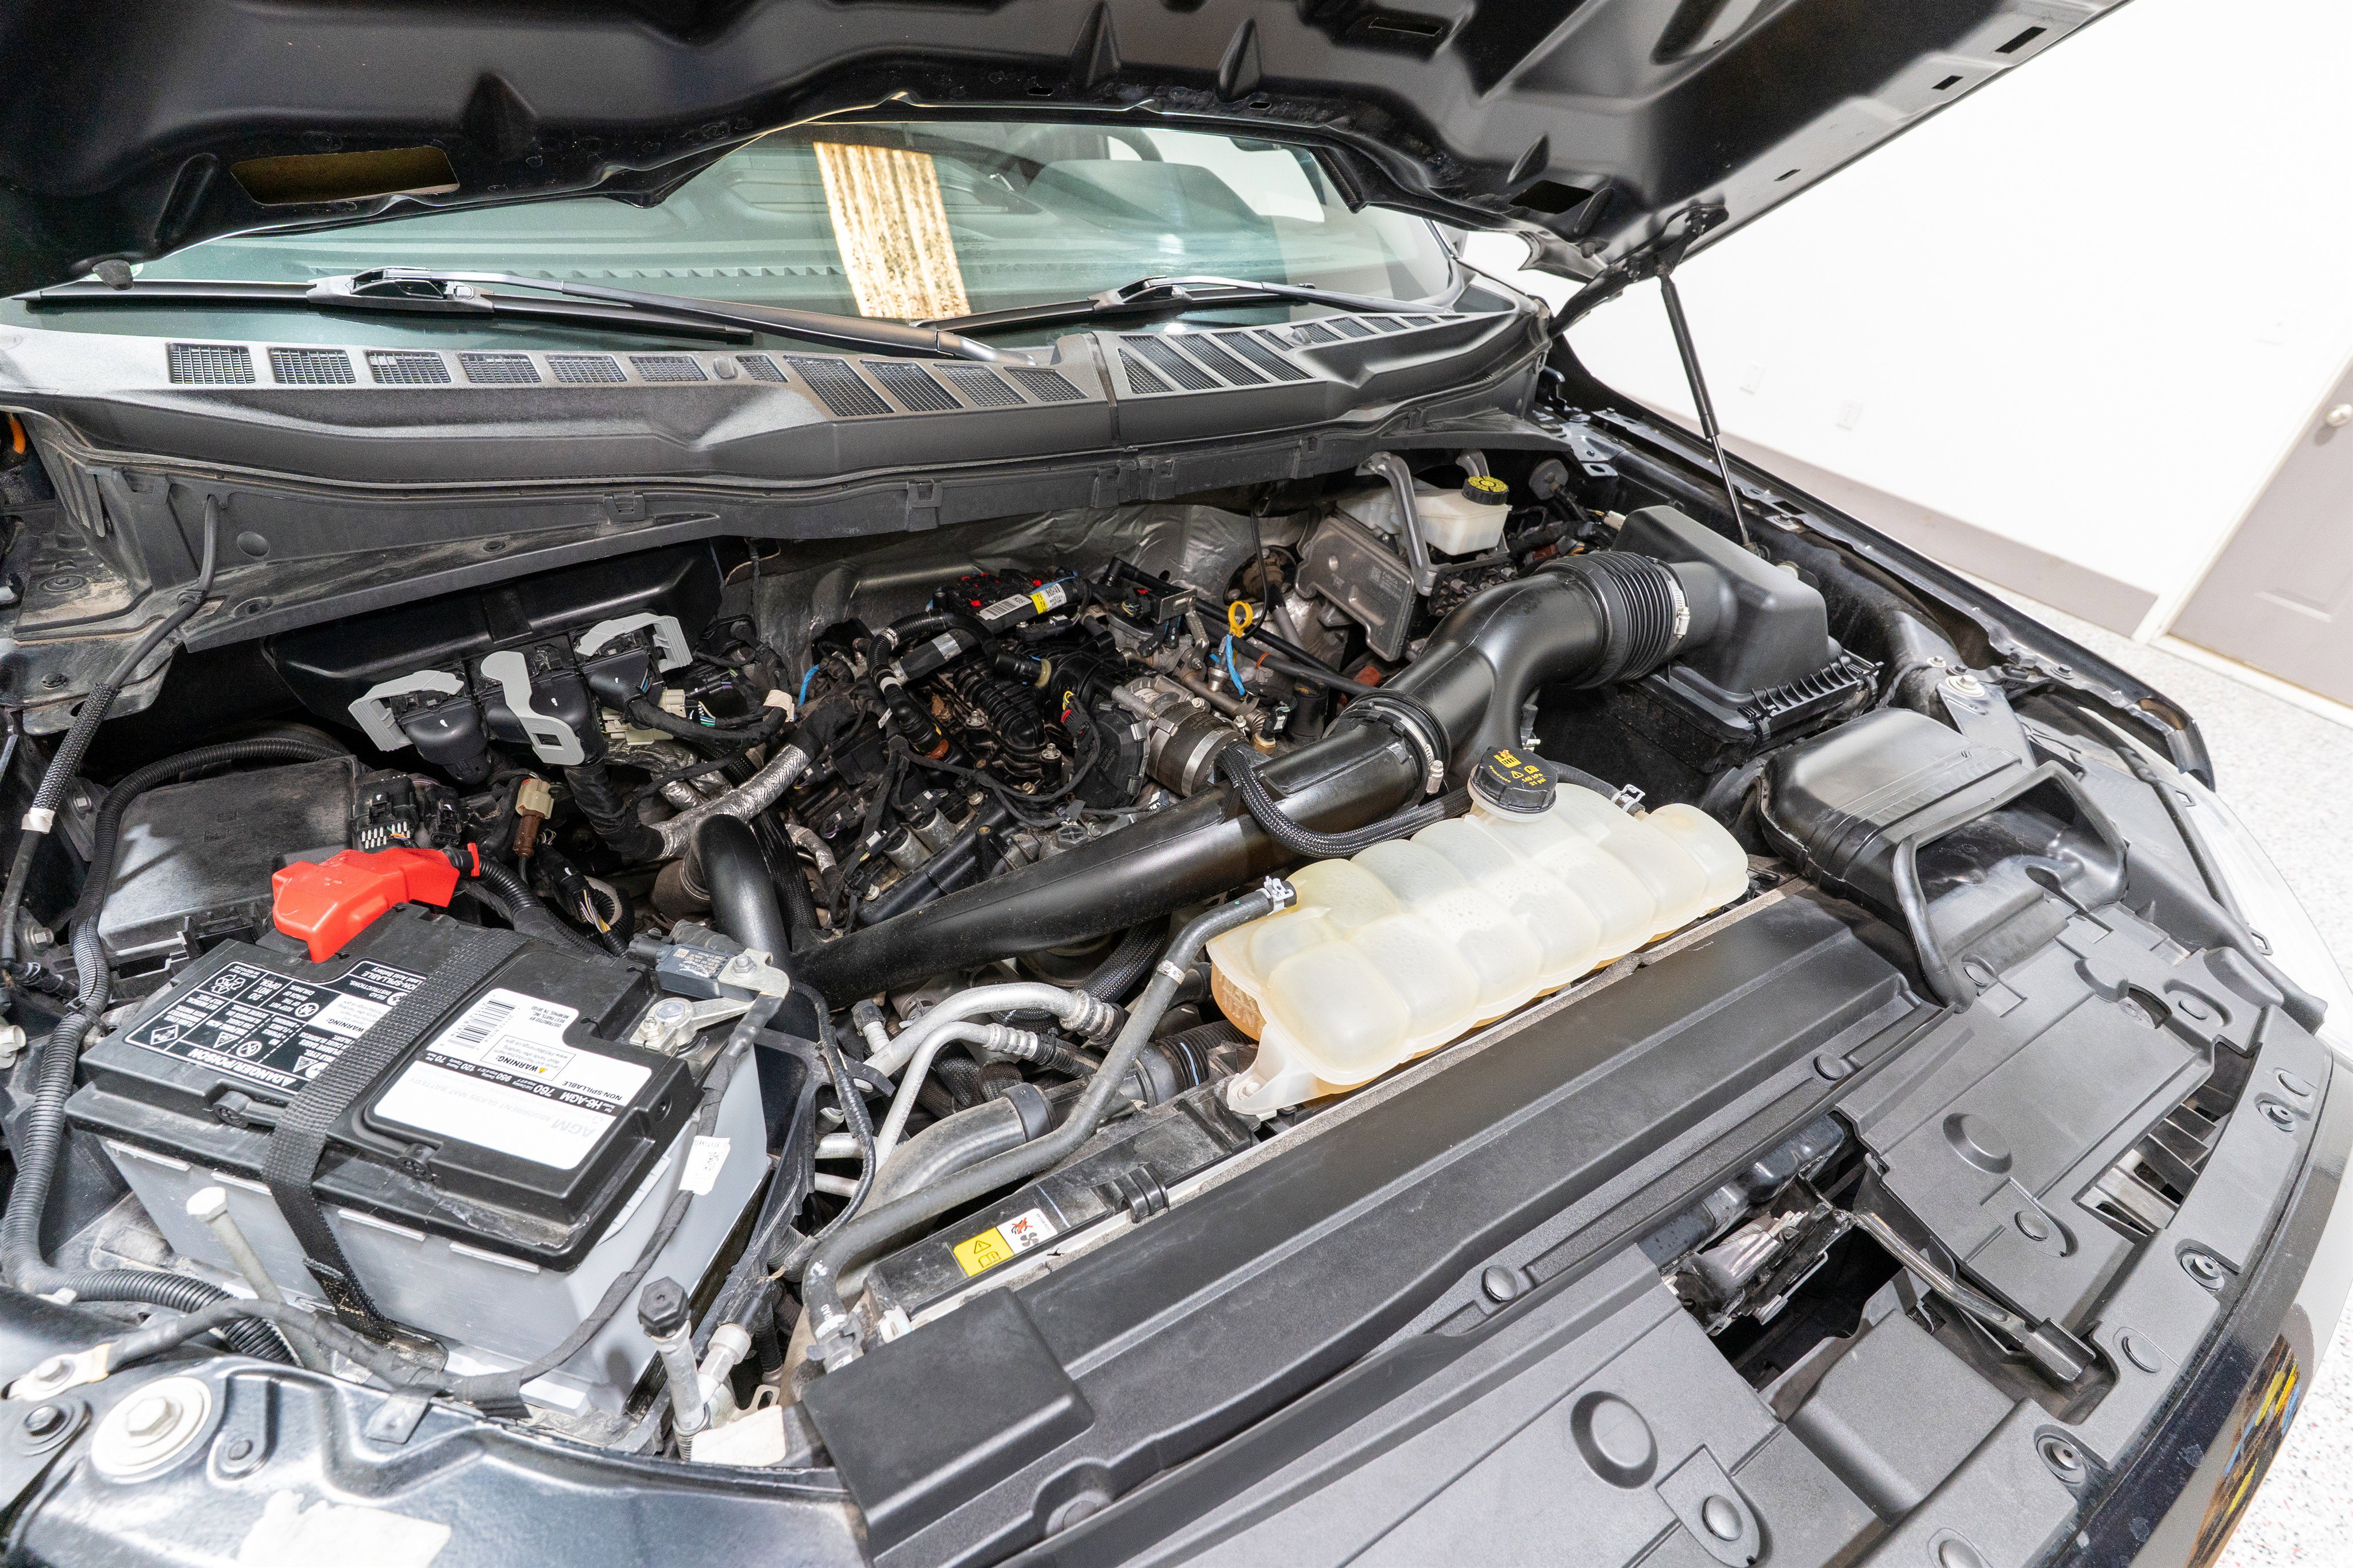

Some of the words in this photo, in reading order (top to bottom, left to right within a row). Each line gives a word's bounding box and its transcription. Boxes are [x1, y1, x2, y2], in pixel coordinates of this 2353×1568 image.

[371, 967, 394, 976] Battery
[260, 978, 282, 990] OPEN.
[405, 977, 423, 985] Lead
[253, 986, 272, 995] NOT
[289, 984, 315, 995] CHILDREN.
[349, 980, 392, 995] INSTRUCTIONS.
[248, 992, 263, 1001] DO
[289, 992, 308, 1001] REACH
[368, 992, 387, 1000] READ
[233, 1012, 261, 1024] BLINDNESS
[248, 1009, 268, 1018] SEVERE
[326, 1018, 364, 1032] WARNING:
[535, 1018, 561, 1028] DISTRIBUTED
[188, 1048, 286, 1083] DANGER/POISON
[460, 1063, 475, 1071] 120
[496, 1055, 538, 1071] WARNING:
[495, 1073, 512, 1082] 950
[408, 1077, 448, 1091] BATTERY
[448, 1089, 468, 1097] MAT
[533, 1084, 555, 1096] 760
[562, 1081, 622, 1100] NON-SPILLABLE
[469, 1094, 498, 1106] GLASS
[559, 1091, 603, 1109] H6-AGM
[550, 1119, 596, 1137] AGM
